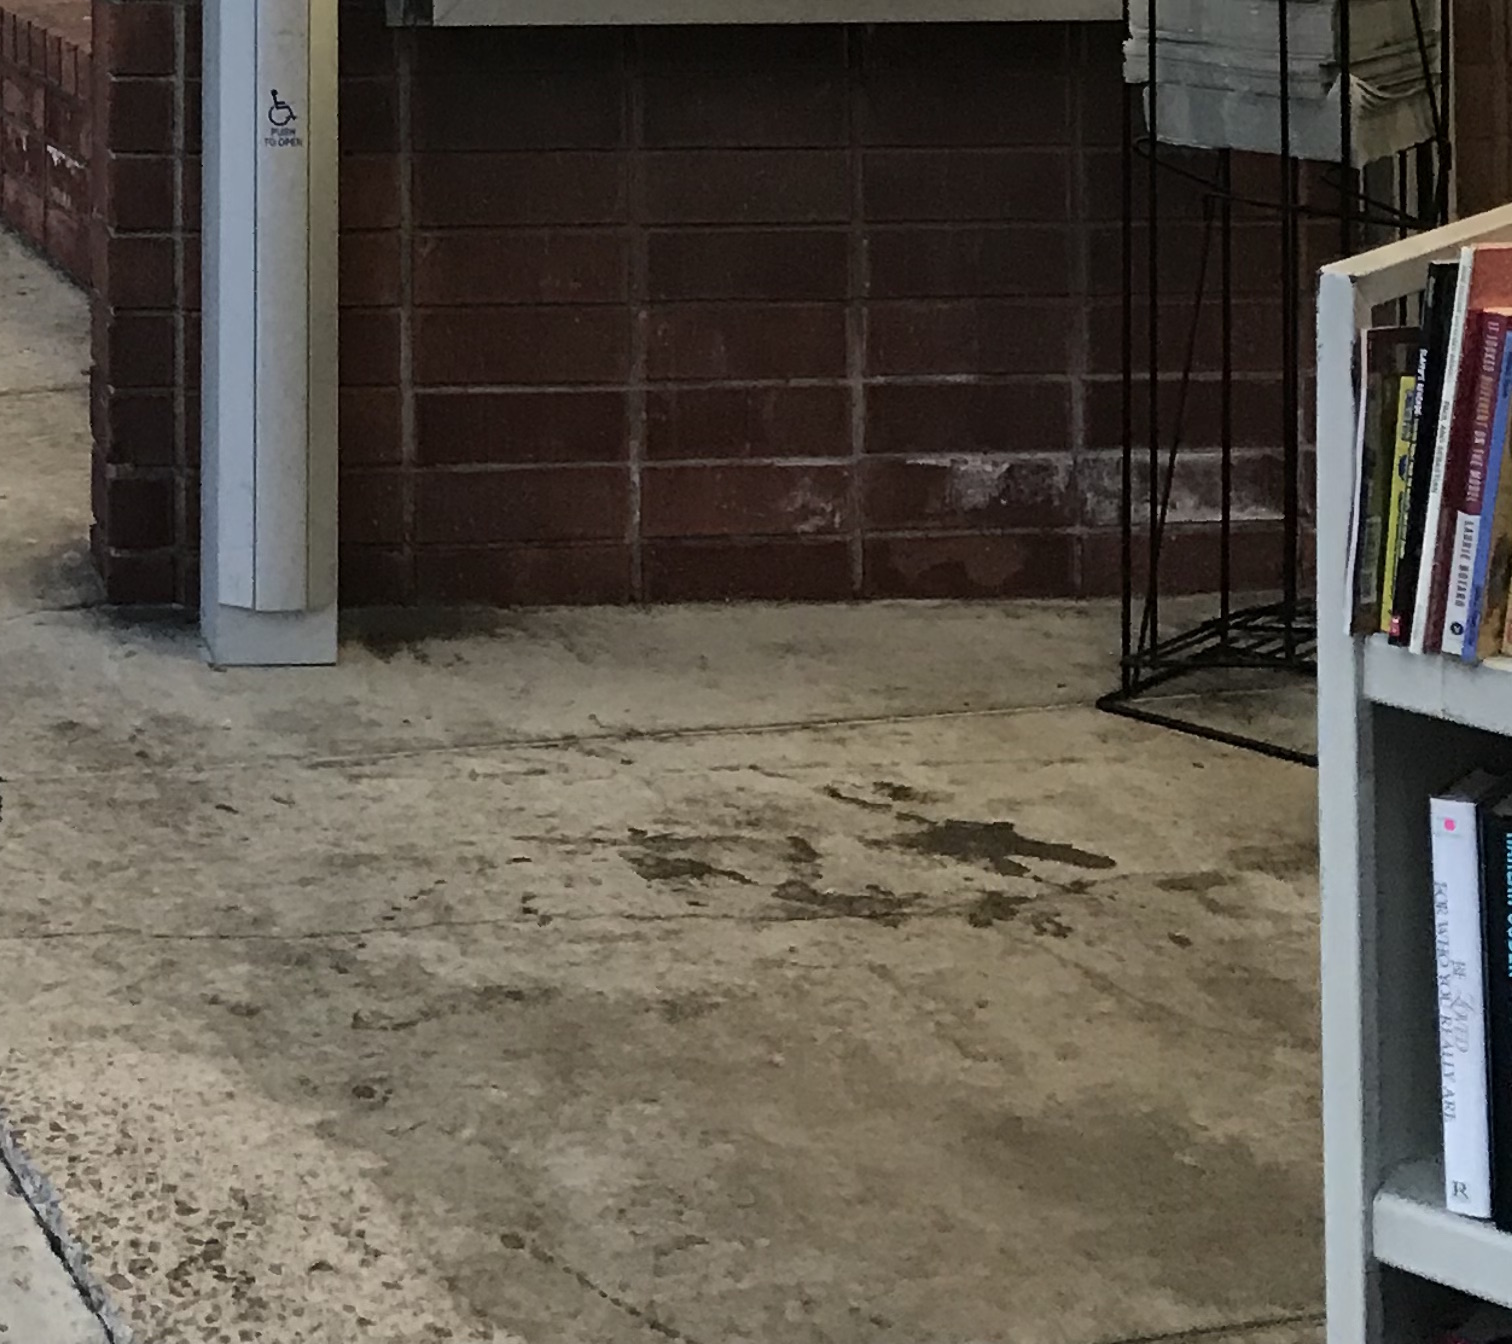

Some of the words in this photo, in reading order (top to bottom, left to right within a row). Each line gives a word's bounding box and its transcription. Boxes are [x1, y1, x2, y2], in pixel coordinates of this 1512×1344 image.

[264, 137, 277, 148] TO
[278, 137, 303, 148] OPEN
[1460, 520, 1475, 561] LAURIE
[1437, 921, 1450, 968] WHO
